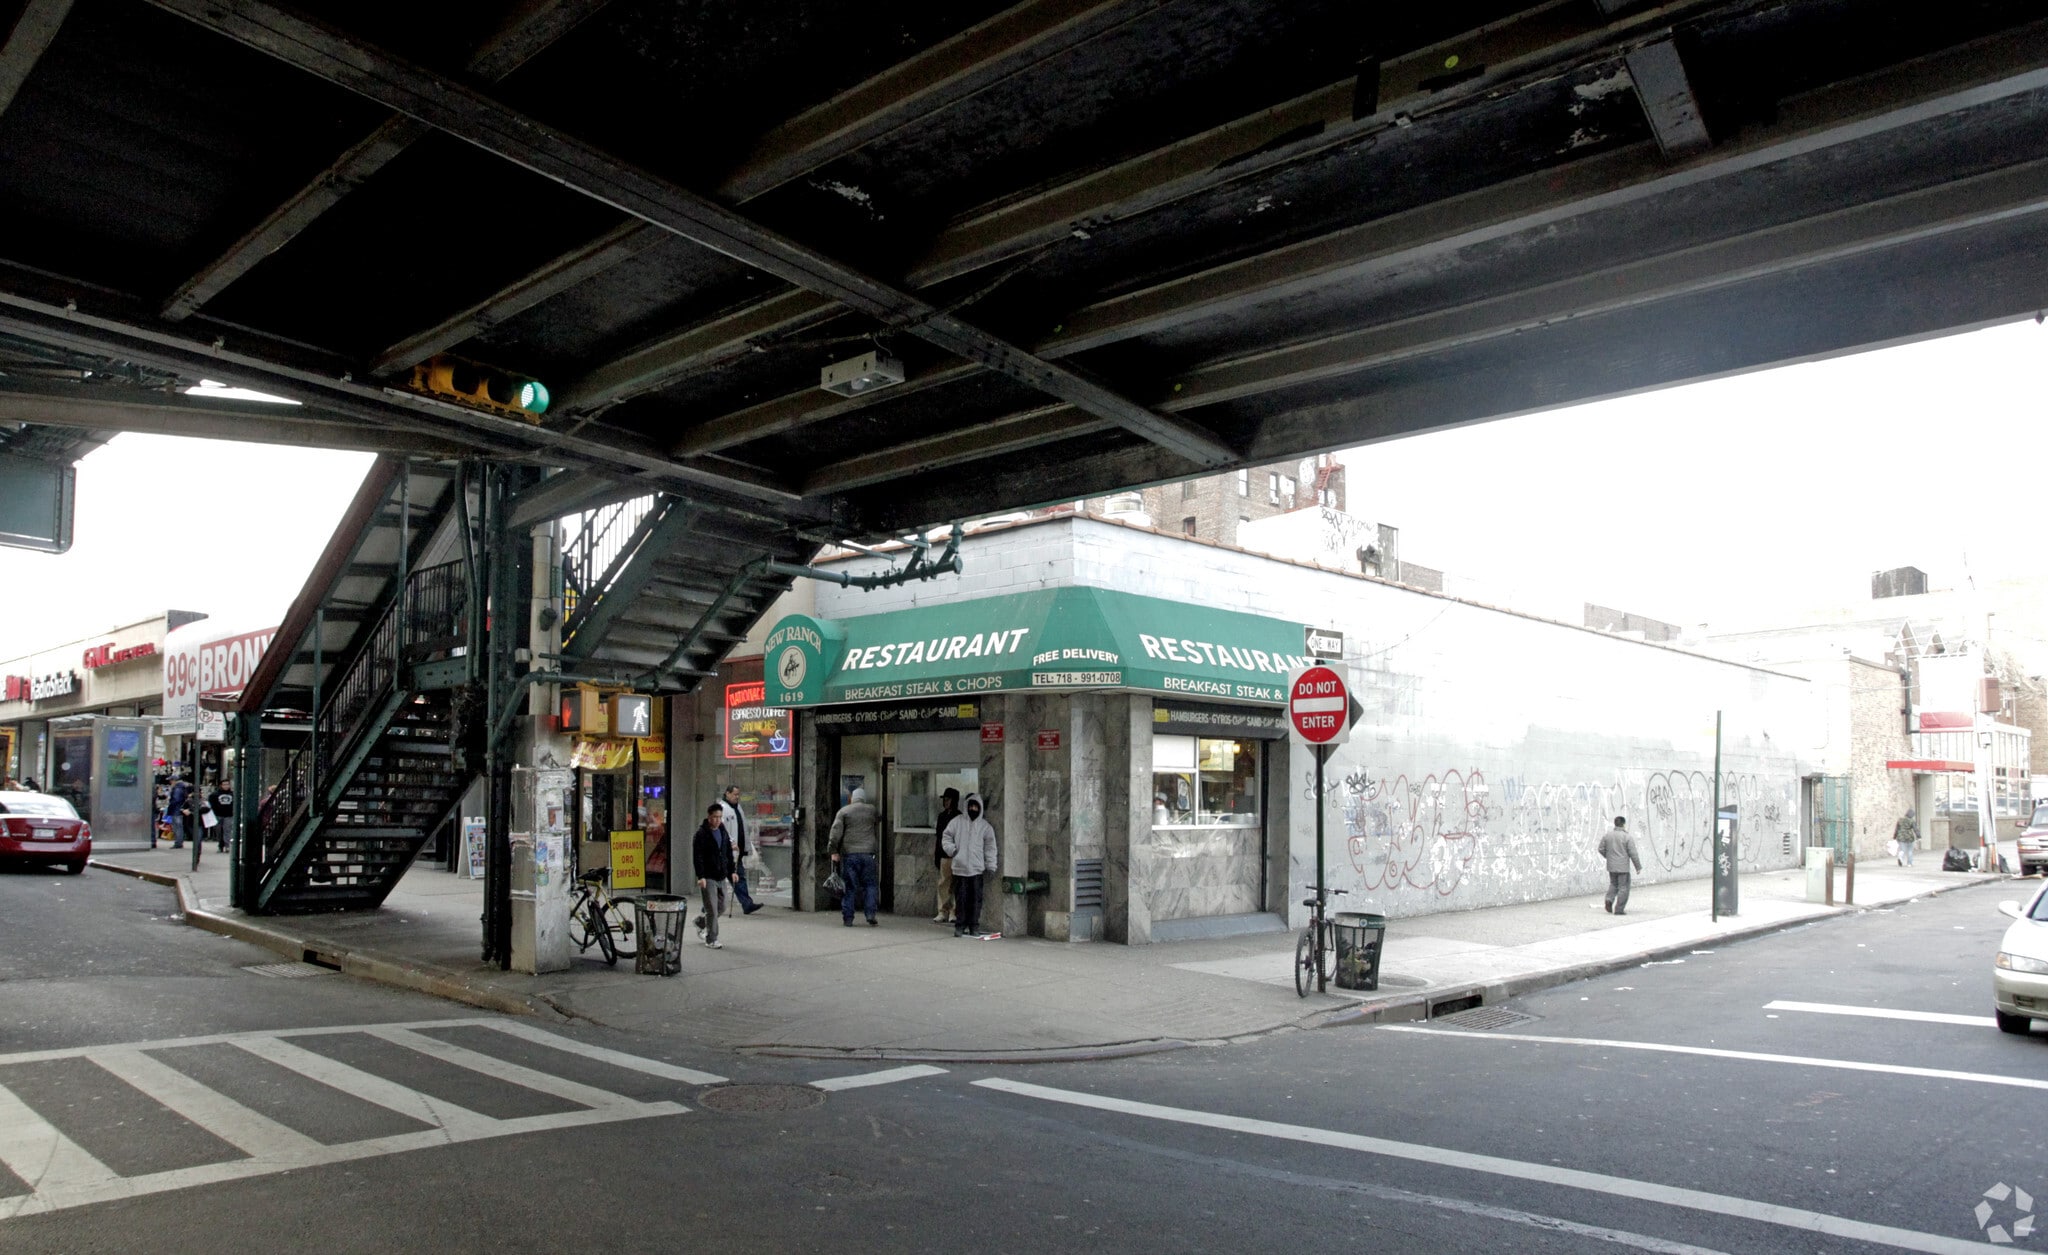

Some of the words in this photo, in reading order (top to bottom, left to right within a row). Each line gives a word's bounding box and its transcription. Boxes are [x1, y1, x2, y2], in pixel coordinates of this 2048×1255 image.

[764, 628, 786, 659] NEW
[786, 626, 821, 654] RANCH
[841, 628, 1030, 671] RESTAURANT
[1311, 637, 1322, 649] ONE
[1327, 640, 1339, 650] WAY
[83, 642, 116, 669] GNC
[1033, 650, 1059, 666] FREE
[1062, 649, 1119, 664] DELIVERY
[1034, 674, 1054, 684] TEL:
[1056, 674, 1072, 683] 718
[1081, 672, 1121, 683] 991-0708
[31, 676, 73, 700] RadioShack
[845, 688, 902, 700] BREAKFAST
[905, 682, 939, 695] STEAK
[943, 680, 953, 692] &
[956, 676, 1002, 692] CHOPS
[1164, 677, 1231, 696] BREAKFAST
[1236, 685, 1270, 699] STEAK
[1274, 689, 1283, 700] &
[1299, 683, 1313, 694] DO
[1316, 681, 1337, 693] NOT
[779, 691, 804, 702] 1619
[731, 707, 761, 720] ESPRESSO
[815, 713, 852, 724] HAMBURGERS
[855, 711, 877, 722] GYROS
[899, 707, 918, 720] SAND
[938, 706, 958, 717] SAND
[1170, 710, 1209, 724] HAMBURGERS
[1211, 713, 1231, 725] GYROS
[1247, 717, 1261, 727] SAND
[1302, 716, 1335, 728] ENTER
[612, 842, 642, 850] COMPRAMOS
[621, 855, 634, 864] ORO
[616, 867, 640, 878] EMPEÑO
